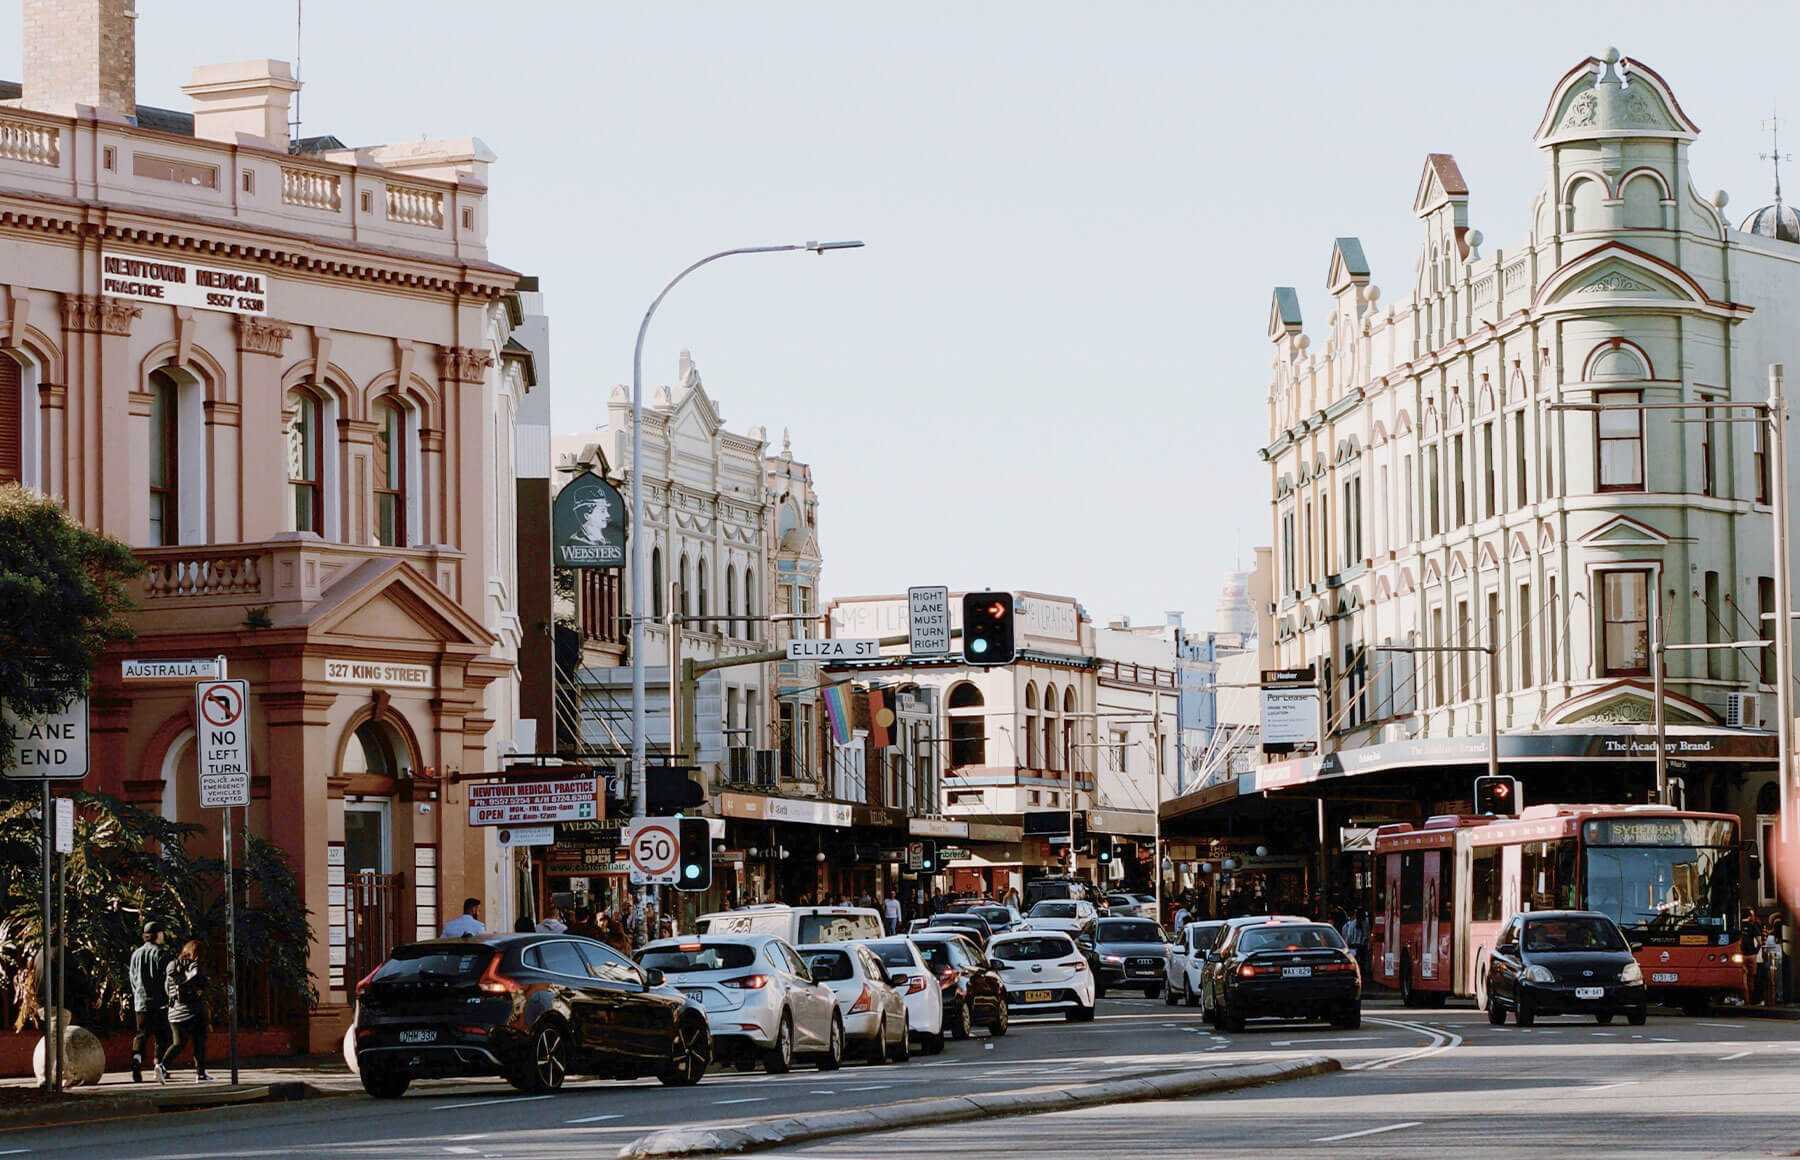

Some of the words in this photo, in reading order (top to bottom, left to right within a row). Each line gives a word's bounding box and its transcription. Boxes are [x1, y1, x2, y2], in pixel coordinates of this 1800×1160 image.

[104, 256, 186, 284] NEWTOWN
[196, 269, 264, 294] MEDICAL
[104, 278, 165, 298] PRACTICE
[206, 292, 234, 307] 9557
[560, 545, 621, 560] WEBSTERS
[912, 592, 944, 601] RIGHT
[913, 604, 944, 613] LANE
[914, 615, 943, 625] MUST
[916, 627, 944, 636] TURN
[793, 643, 844, 655] ELIZA
[855, 642, 874, 654] ST
[914, 639, 945, 648] RIGHT
[126, 665, 198, 676] AUSTRALIA
[328, 663, 349, 678] 327
[352, 665, 382, 680] KING
[384, 666, 429, 682] STREET
[12, 724, 75, 740] LANE
[212, 731, 236, 746] NO
[1605, 740, 1627, 751] The
[1630, 741, 1677, 753] Acadmy
[21, 749, 67, 765] END
[208, 750, 239, 760] LEFT
[208, 765, 241, 773] TURN
[473, 786, 516, 798] NEWTOWN
[519, 784, 553, 797] MEDICAL
[554, 782, 593, 794] PRACTICE
[479, 809, 504, 820] OPEN
[1613, 824, 1681, 834] SYDENHAM
[640, 840, 670, 860] 50
[585, 855, 611, 864] OPEN
